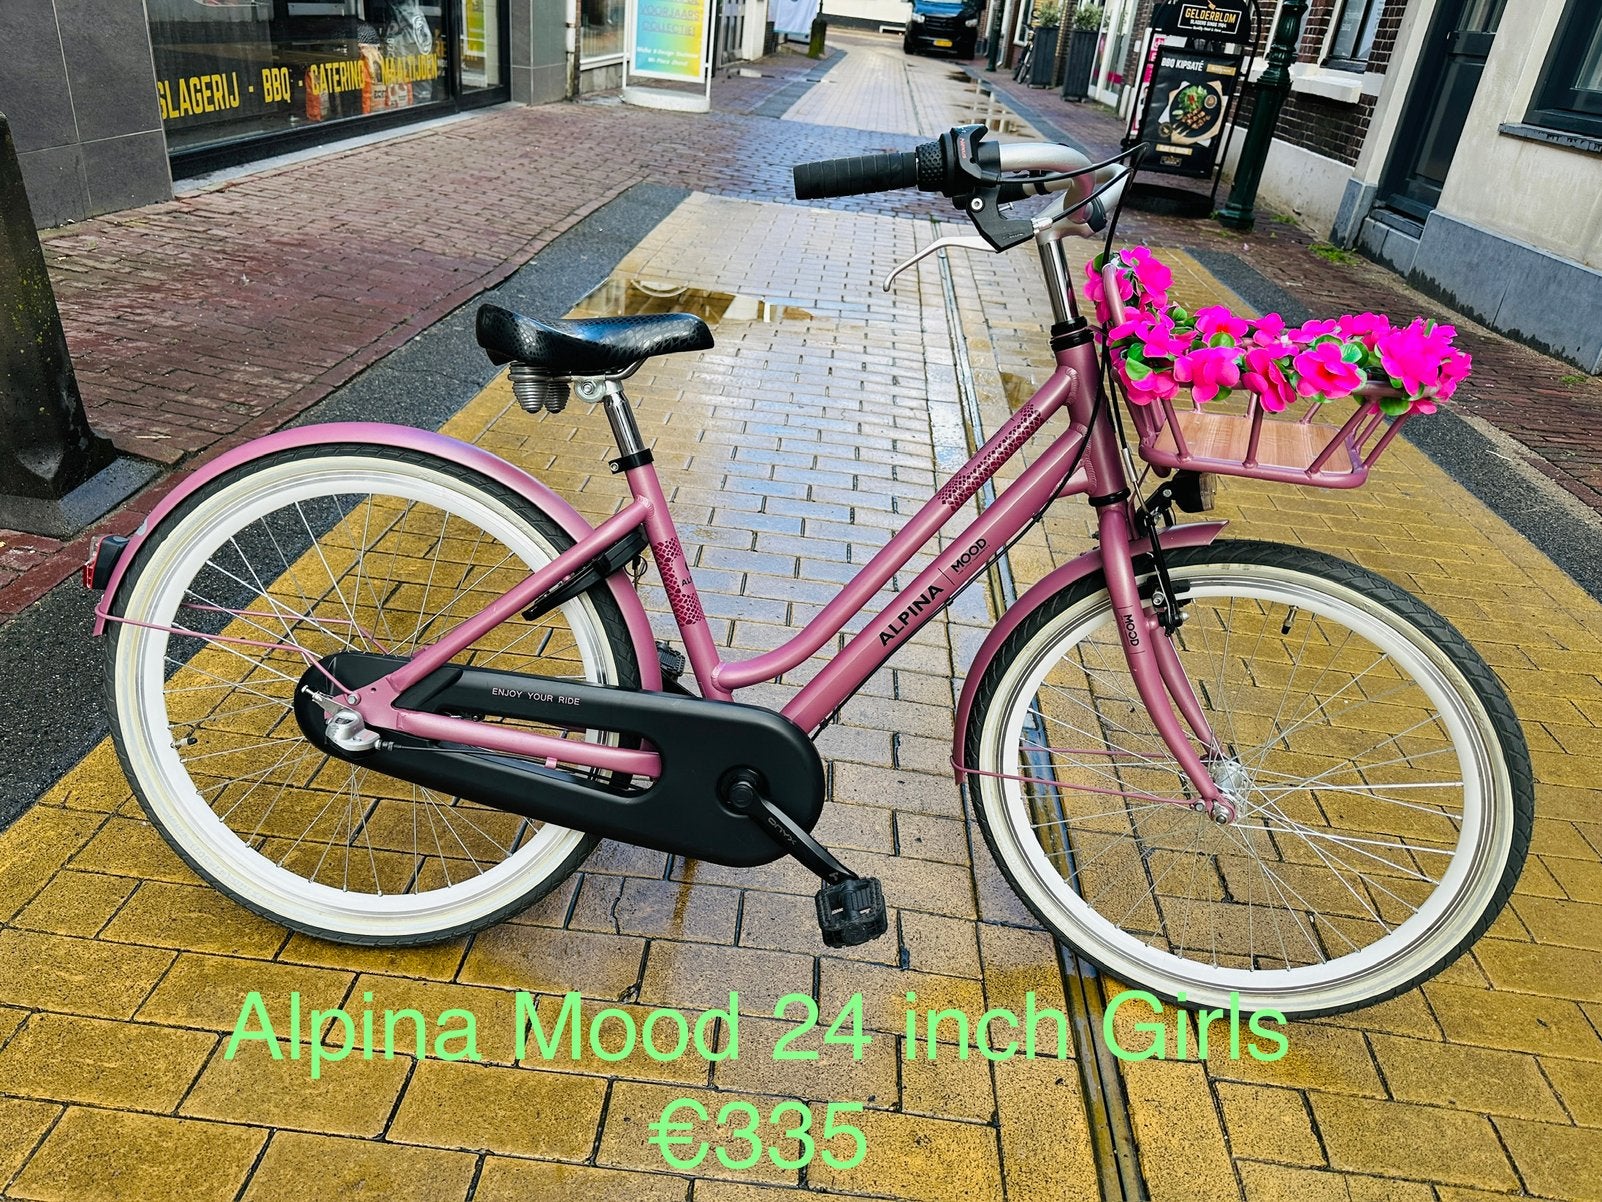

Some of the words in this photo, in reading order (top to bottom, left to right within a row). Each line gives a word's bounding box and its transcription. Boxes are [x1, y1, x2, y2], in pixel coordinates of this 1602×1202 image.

[1185, 8, 1237, 23] GELDERBLOM
[1175, 59, 1205, 71] KIPSATÉ
[157, 72, 240, 120] SLAGERIJ
[262, 66, 291, 103] BBQ
[310, 60, 366, 96] CATERING
[879, 585, 944, 646] ALPINA
[950, 538, 987, 572] MOOD
[1123, 613, 1140, 646] MOOD
[492, 687, 523, 698] ENJOY
[527, 692, 554, 702] YOUR
[558, 696, 580, 706] RIDE
